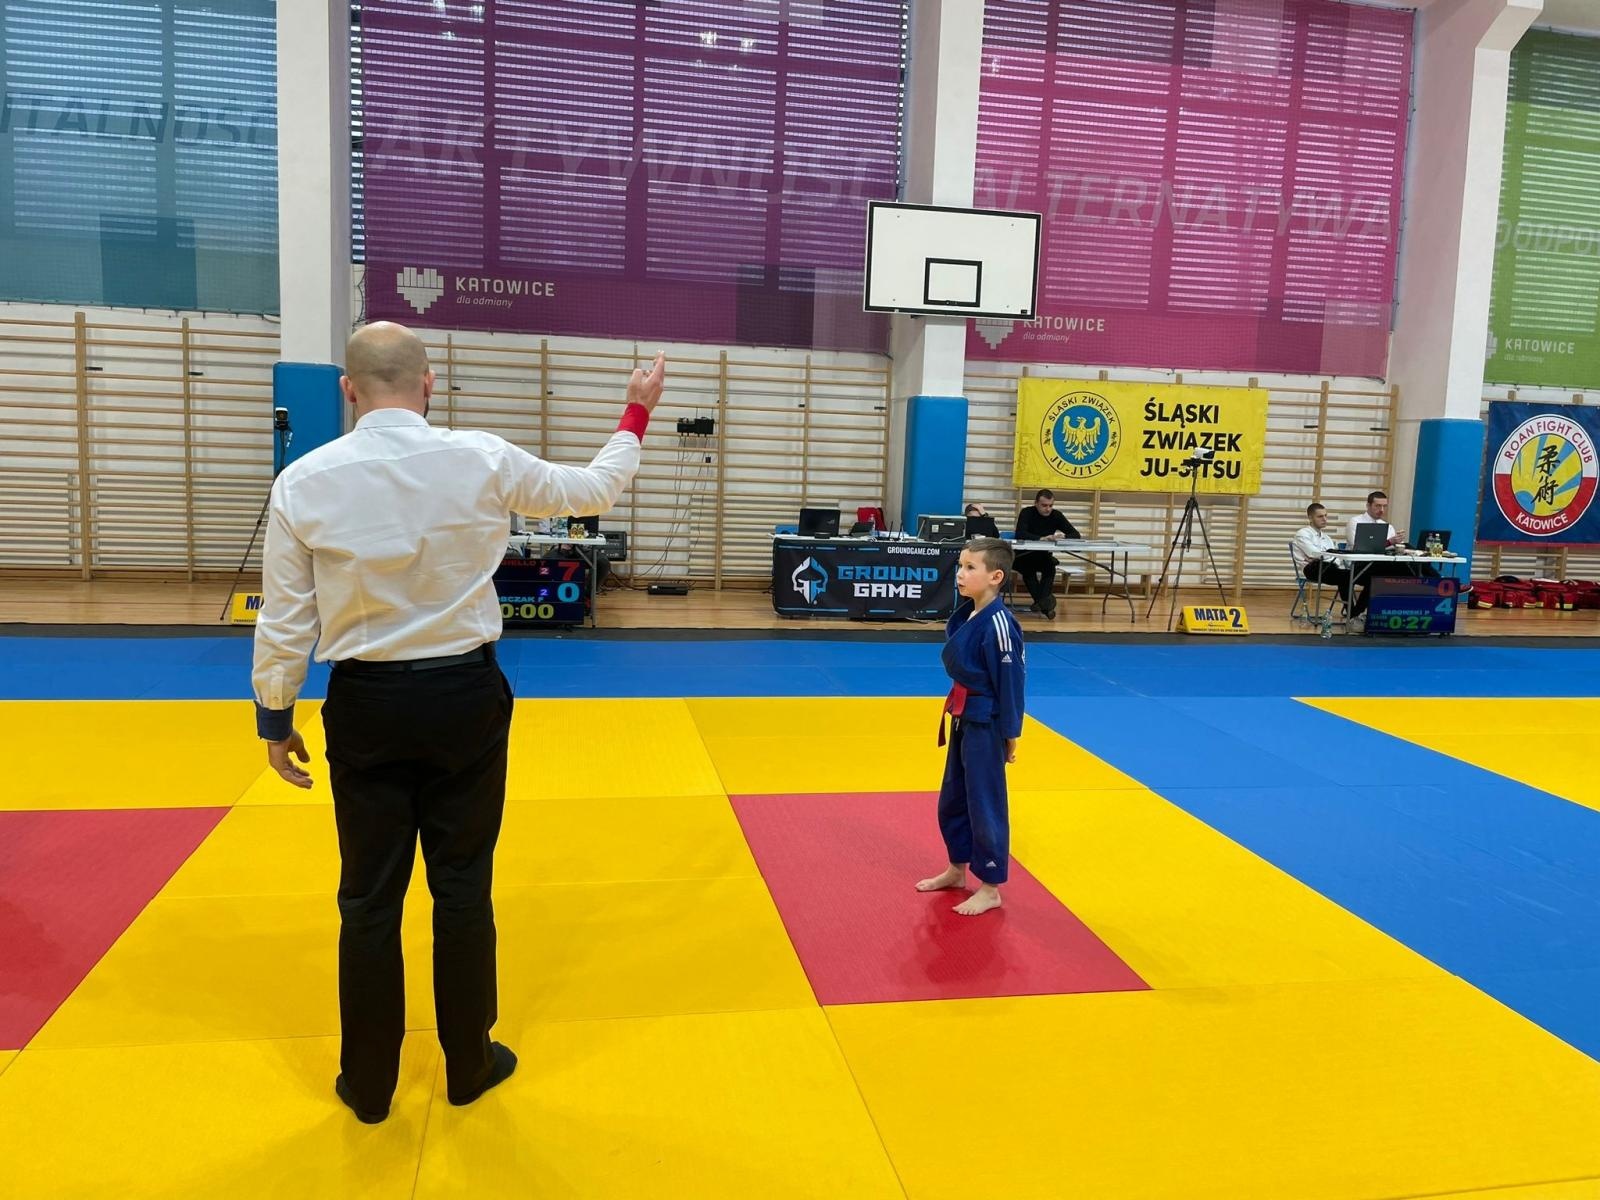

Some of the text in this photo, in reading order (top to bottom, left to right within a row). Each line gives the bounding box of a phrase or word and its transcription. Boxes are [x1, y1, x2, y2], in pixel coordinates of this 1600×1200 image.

[455, 276, 555, 297] KATOWICE
[456, 295, 513, 309] dla odmiany
[1023, 332, 1070, 344] dla odmiany
[1505, 338, 1576, 354] KATOWICE
[1143, 396, 1220, 429] ŚLĄSKI
[1504, 420, 1593, 464] ROAN FIGHT CLUB
[1515, 511, 1569, 530] KATOWICE
[887, 546, 940, 556] GROUNDGAME.COM
[558, 561, 580, 581] 7
[838, 566, 938, 581] GROUND
[557, 583, 579, 602] 0
[853, 582, 922, 599] GAME
[1439, 580, 1454, 595] 0
[1435, 598, 1453, 614] 4
[1194, 608, 1243, 627] MATA 2
[1389, 615, 1433, 630] 0:27
